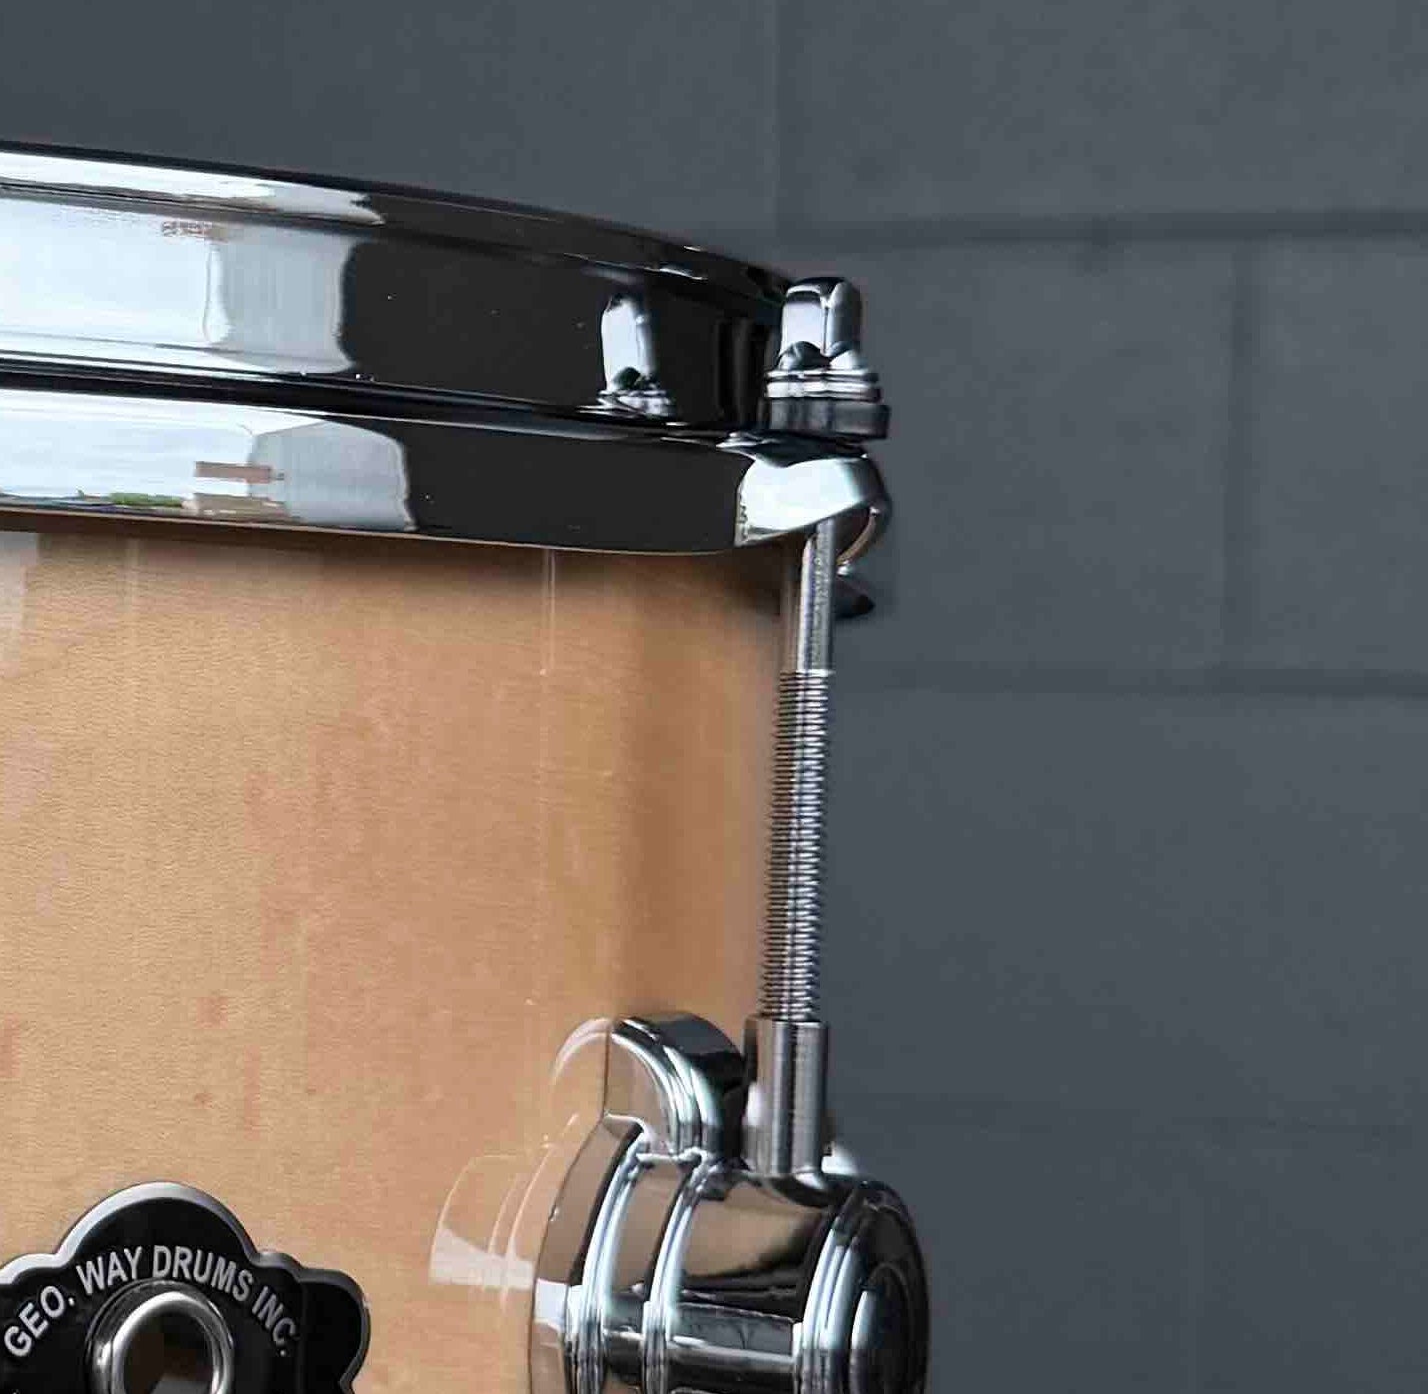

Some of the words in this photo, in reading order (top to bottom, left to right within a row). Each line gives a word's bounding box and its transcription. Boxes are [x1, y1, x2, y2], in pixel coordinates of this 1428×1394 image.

[3, 1285, 76, 1358] GEO.
[76, 1245, 144, 1297] WAY
[151, 1244, 254, 1302] DRUMS
[251, 1289, 301, 1358] INC.
